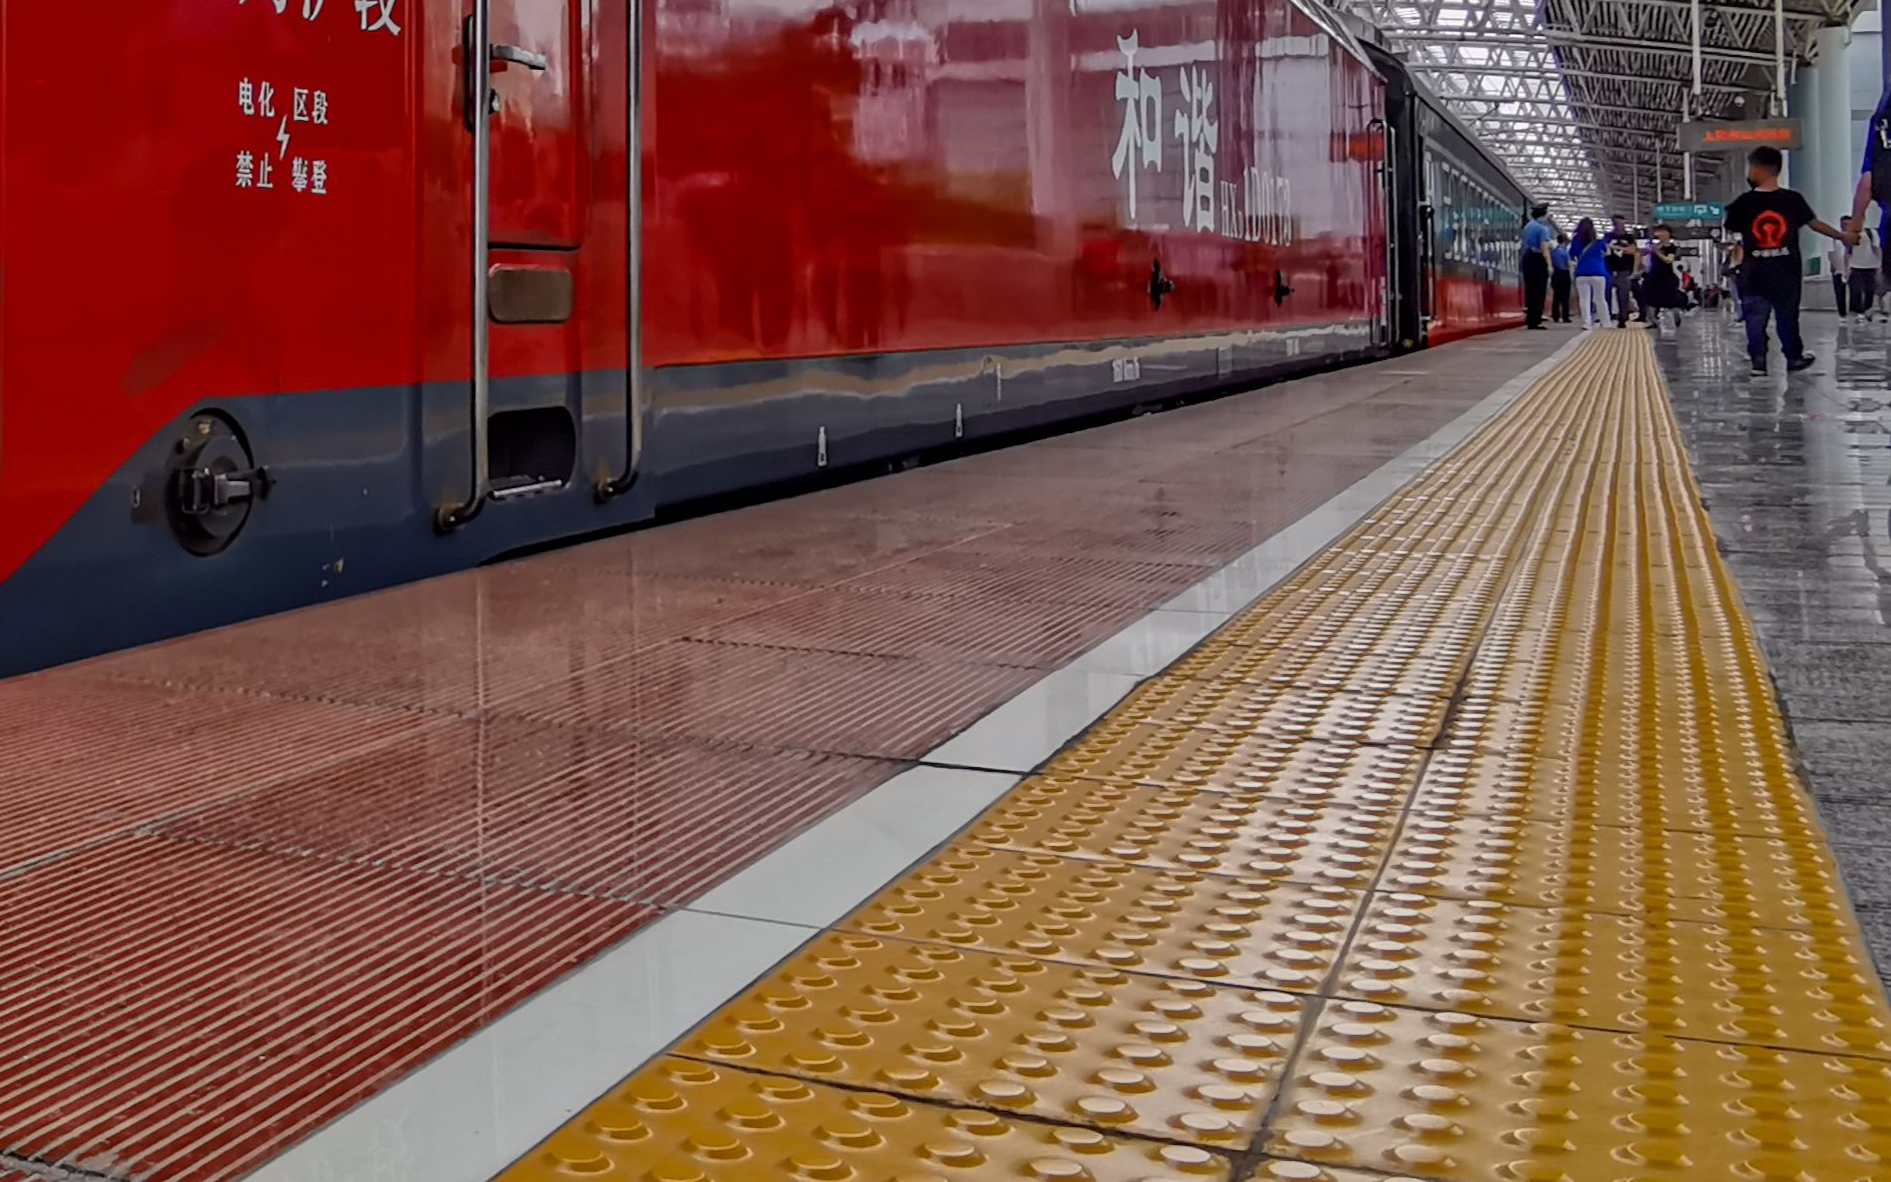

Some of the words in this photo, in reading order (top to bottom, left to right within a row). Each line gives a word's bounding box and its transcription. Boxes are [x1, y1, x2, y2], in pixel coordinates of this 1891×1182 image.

[239, 77, 275, 117] 电化
[293, 87, 328, 125] 区段
[1112, 28, 1218, 234] 和谐
[236, 150, 274, 189] 禁止
[292, 156, 327, 194] 攀登
